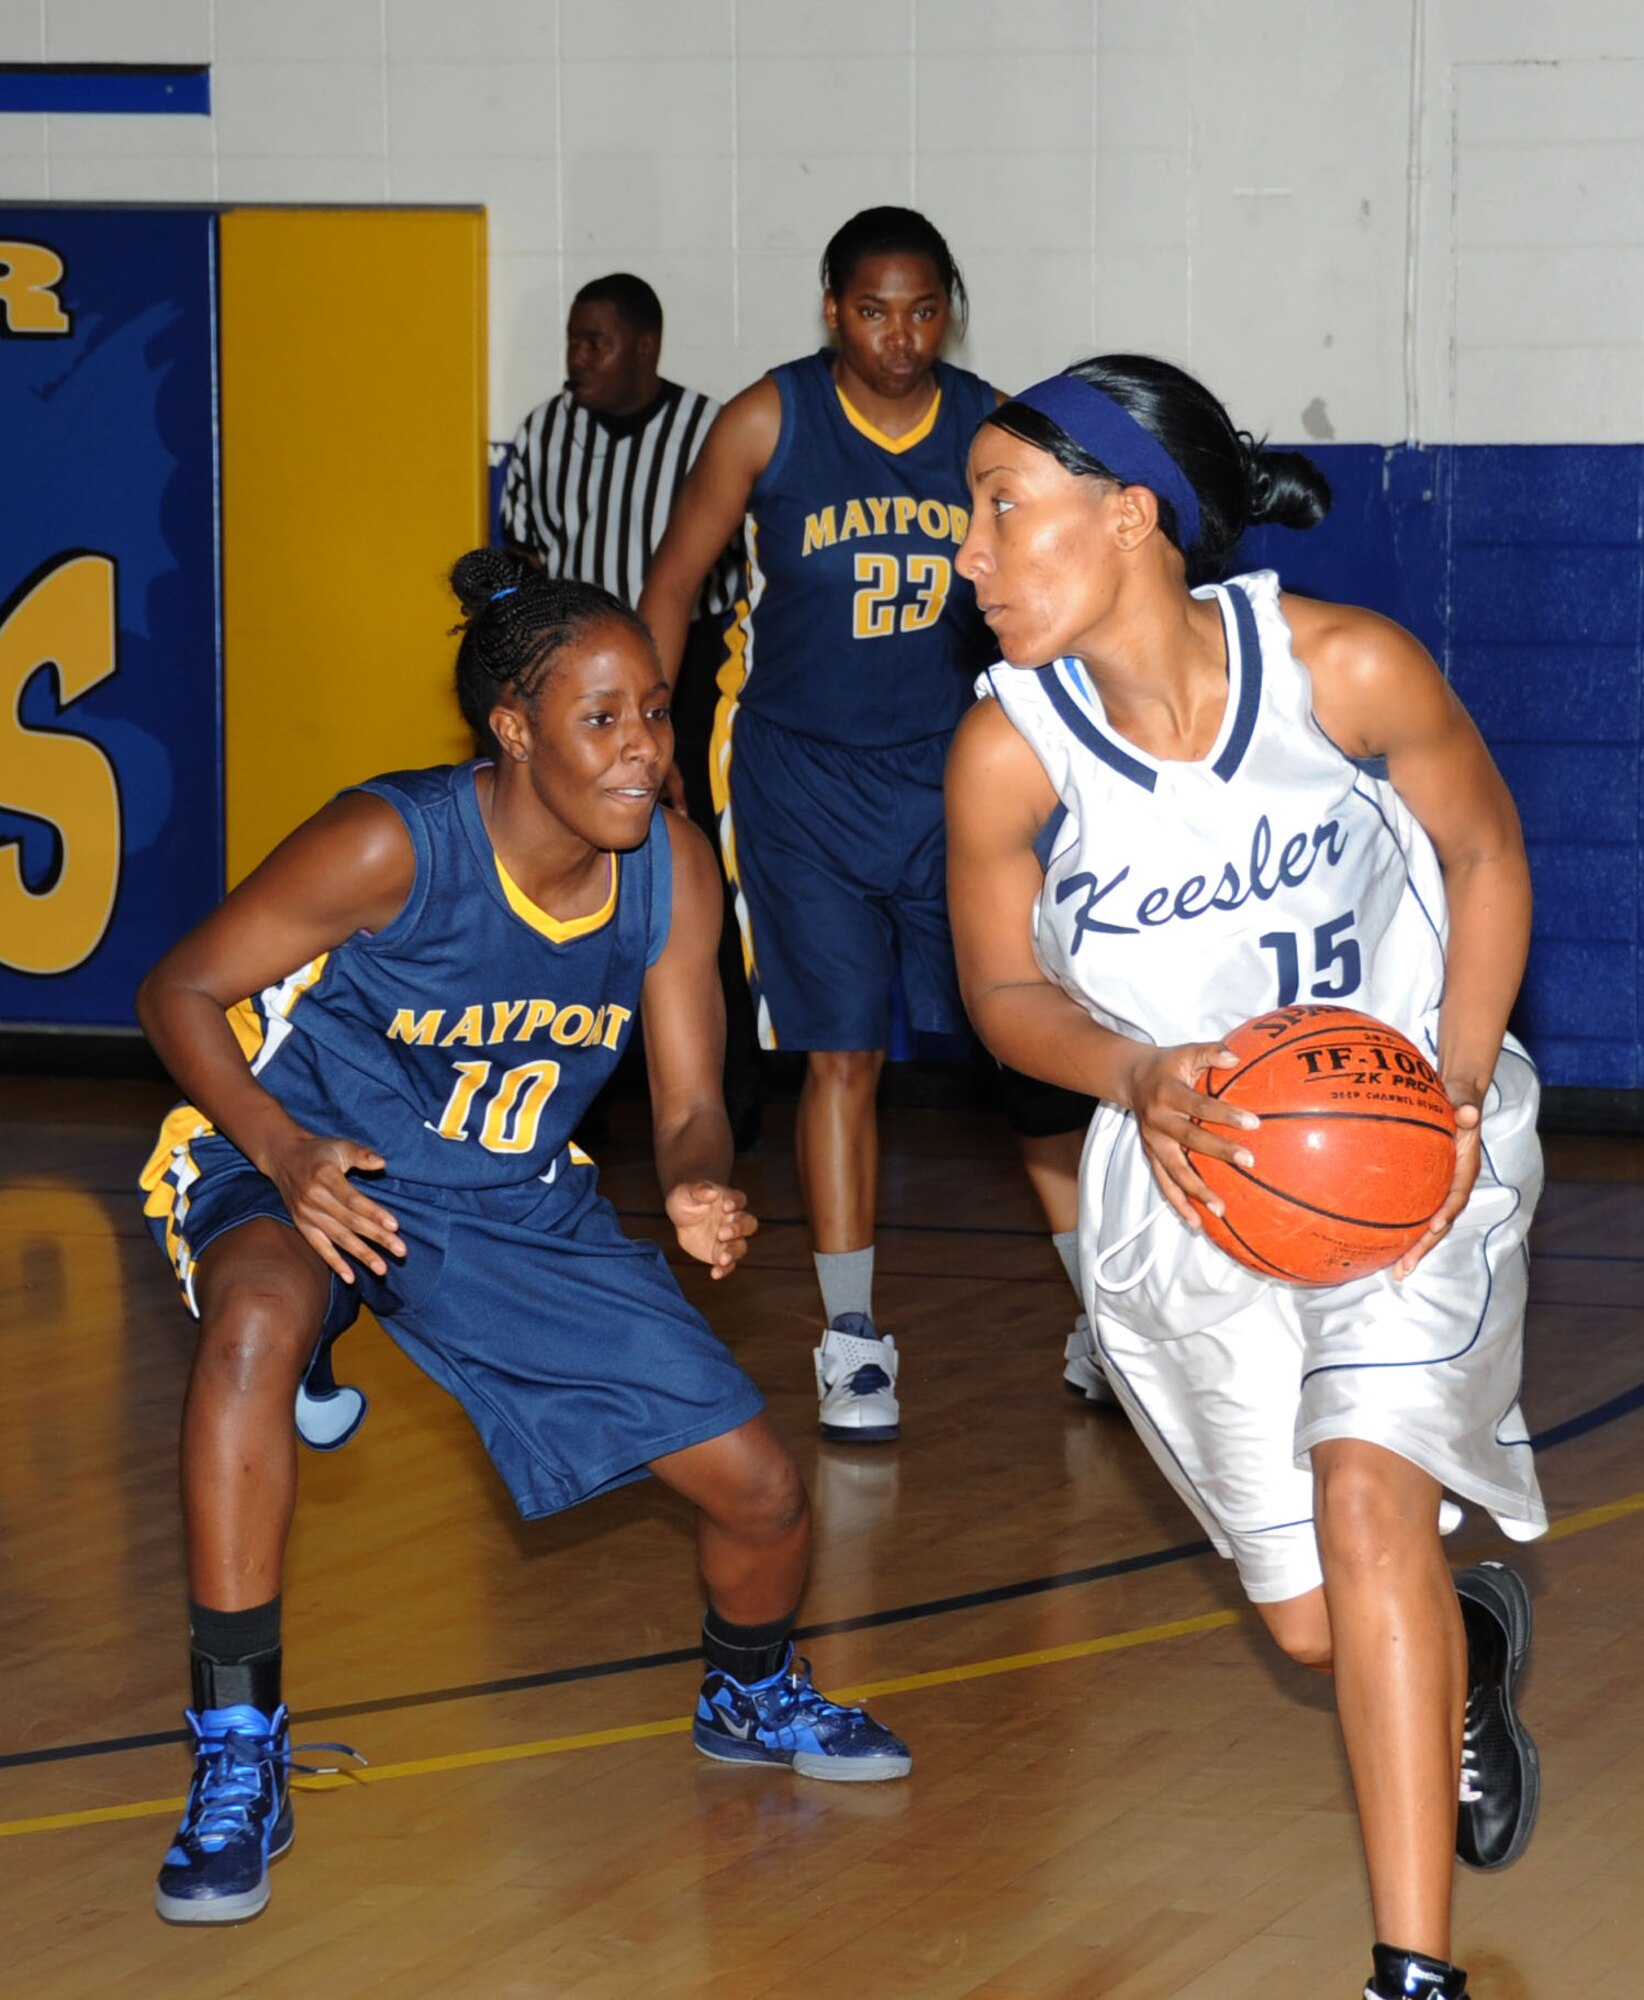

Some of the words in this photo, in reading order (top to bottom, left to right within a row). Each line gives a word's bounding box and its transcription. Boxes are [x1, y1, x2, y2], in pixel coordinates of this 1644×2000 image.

[802, 496, 969, 557] MAYPOR
[853, 553, 951, 639] 23
[0, 555, 120, 975] S
[1055, 814, 1349, 956] Keesler
[1259, 910, 1361, 1008] 15
[424, 1059, 561, 1154] 10
[1297, 1048, 1437, 1085] TF-100
[1353, 1073, 1383, 1085] ZK
[1392, 1075, 1428, 1094] PRO
